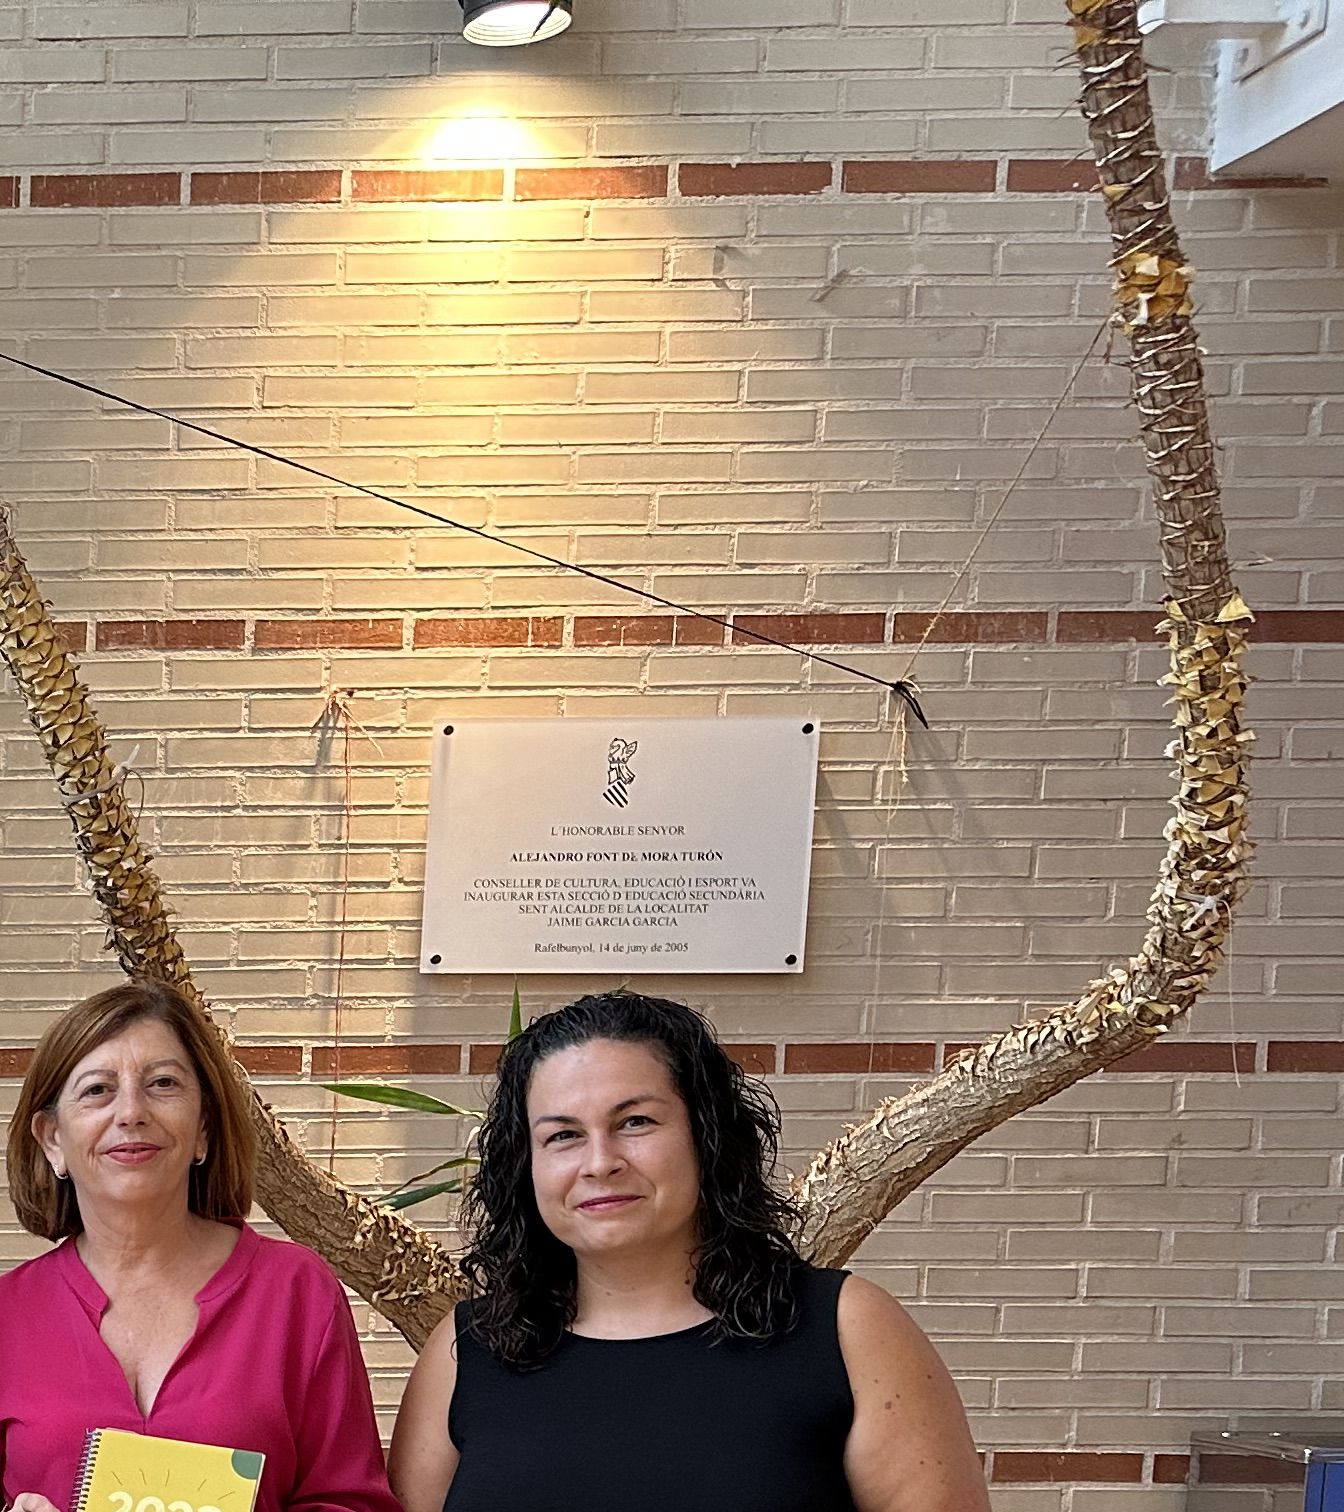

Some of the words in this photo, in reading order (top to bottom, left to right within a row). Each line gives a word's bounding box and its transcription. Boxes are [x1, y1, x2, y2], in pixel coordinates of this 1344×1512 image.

[637, 825, 685, 836] SENYOR
[510, 851, 583, 862] ALEJANDRO
[587, 851, 618, 862] FONT
[622, 851, 637, 862] DE
[641, 851, 678, 862] MORA
[680, 848, 724, 862] TURÓN
[473, 878, 542, 888] CONSELLER
[545, 878, 561, 888] DE
[624, 875, 686, 888] EDUCACIÓ
[695, 877, 738, 888] ESPORT
[741, 877, 756, 888] VA
[463, 891, 534, 902] INAUGURAR
[537, 891, 565, 901] ESTA
[568, 889, 610, 901] SECCIÓ
[518, 904, 548, 914] SENT
[550, 904, 605, 914] ALCALDE
[607, 904, 623, 914] DE
[627, 904, 642, 914] LA
[645, 903, 709, 914] LOCALITAT
[547, 917, 582, 927] JAIME
[599, 943, 610, 953] 14
[613, 943, 624, 953] de
[625, 943, 648, 955] juny
[650, 943, 663, 953] de
[664, 942, 689, 953] 2005
